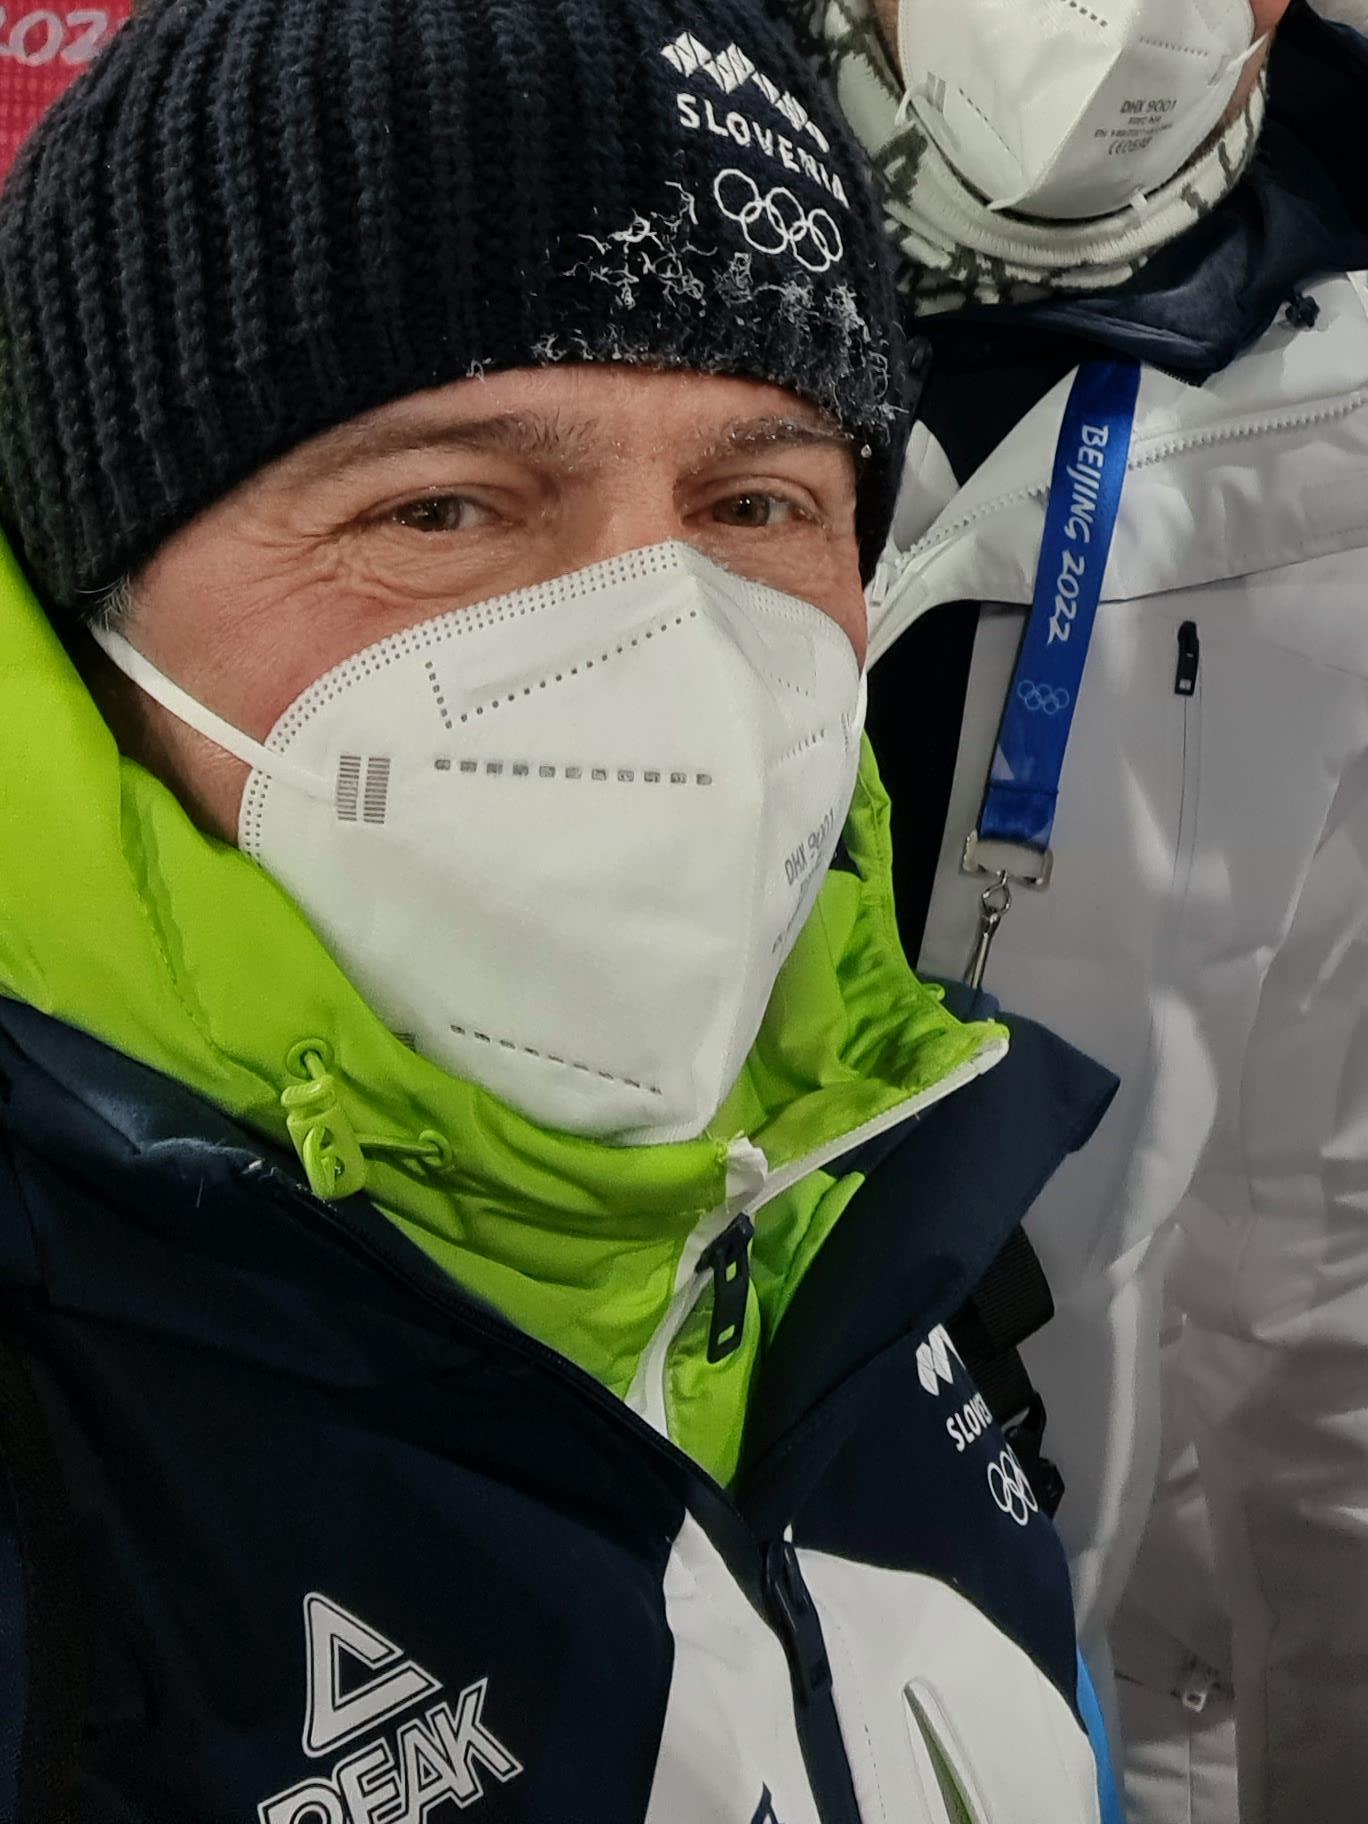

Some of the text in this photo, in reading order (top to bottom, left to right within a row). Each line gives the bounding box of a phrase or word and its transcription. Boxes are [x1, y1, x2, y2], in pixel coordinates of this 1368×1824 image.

[677, 93, 850, 210] SLOVENIA
[1048, 425, 1109, 645] BEIJING 2022
